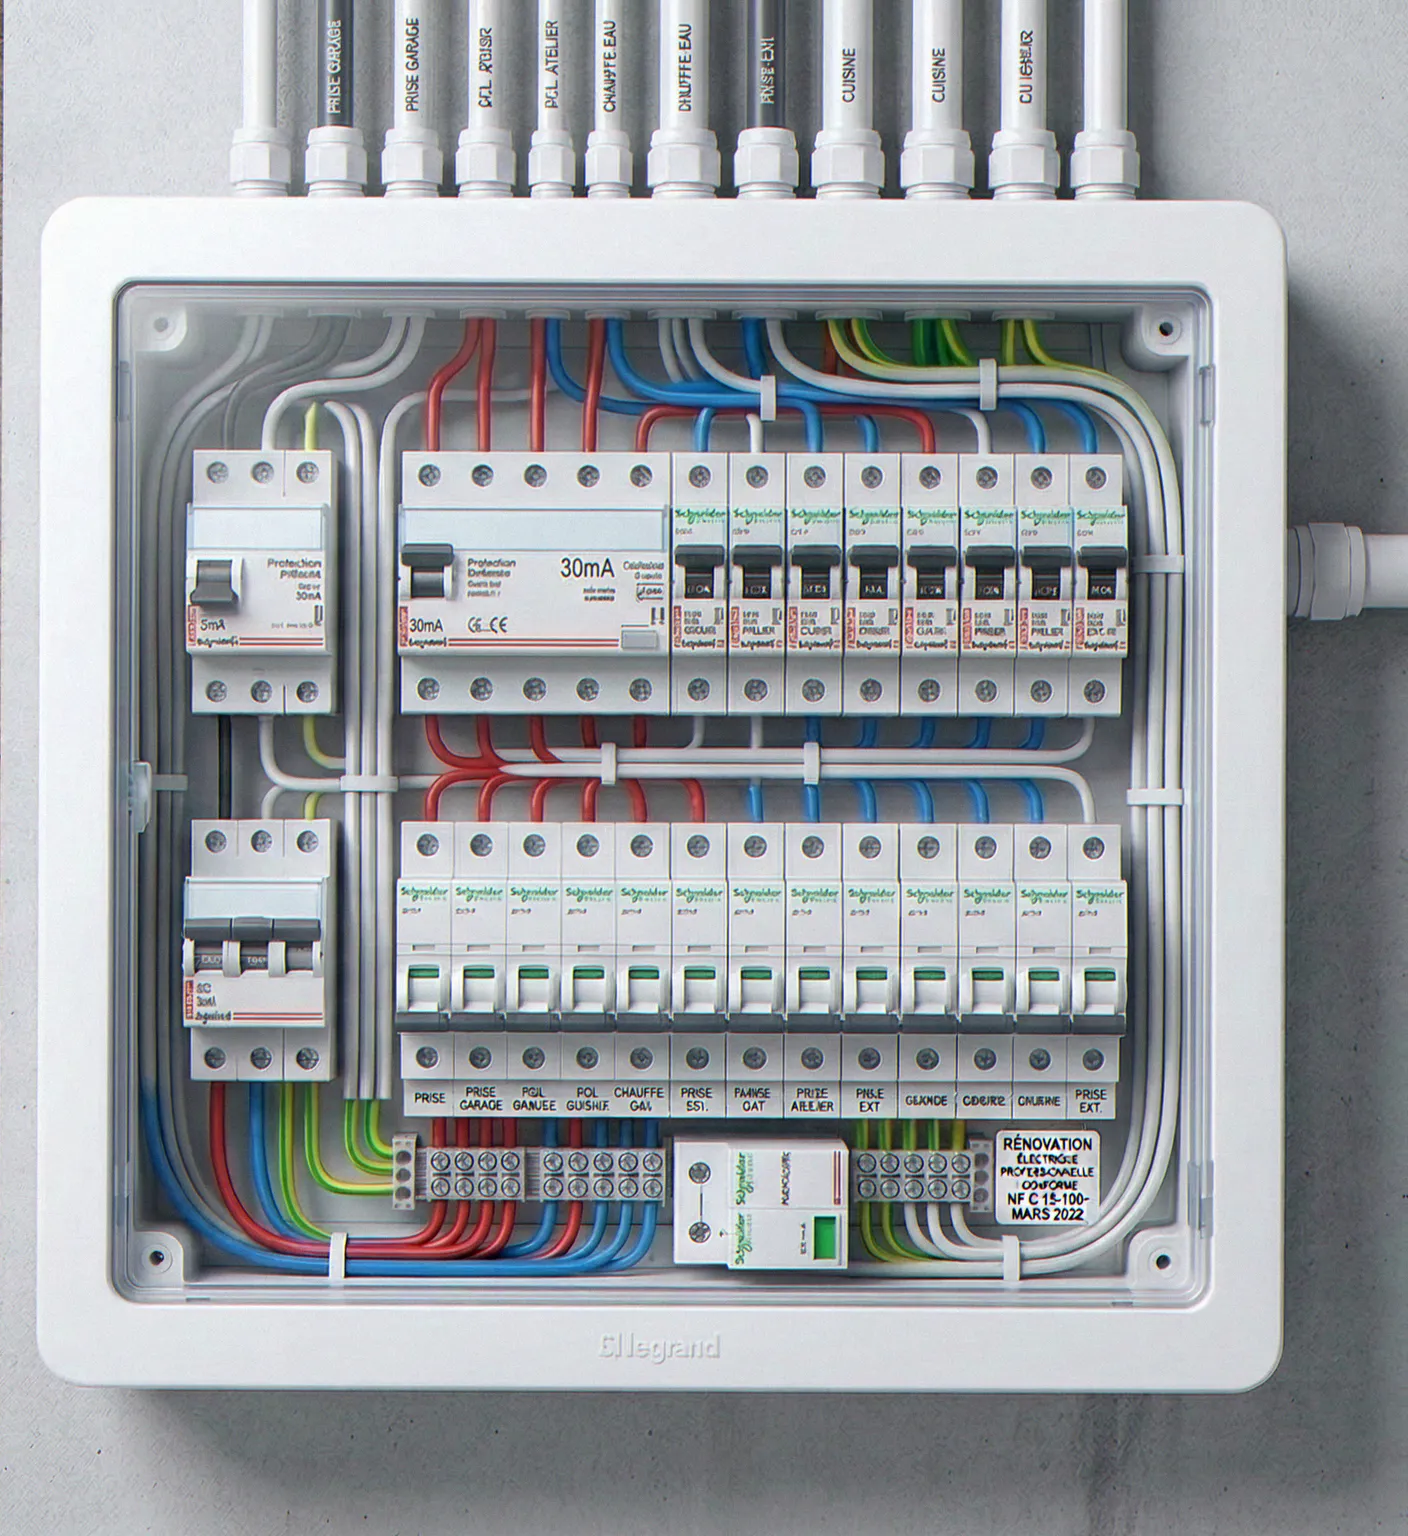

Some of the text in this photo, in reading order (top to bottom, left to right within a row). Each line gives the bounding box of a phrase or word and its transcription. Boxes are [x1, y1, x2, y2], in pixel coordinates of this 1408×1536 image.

[602, 20, 617, 48] EAU
[678, 23, 692, 50] EAU
[545, 20, 559, 75] ATELIER
[405, 18, 420, 112] PRISE GARAGE
[842, 48, 856, 103] CUISINE
[932, 48, 946, 103] CUISINE
[560, 557, 615, 579] 30mA
[409, 617, 444, 633] 30mA
[414, 1092, 446, 1104] PRISE
[465, 1086, 496, 1098] PRISE
[614, 1087, 665, 1098] CHAUFFE
[1075, 1088, 1108, 1100] PRISE
[859, 1101, 881, 1112] EXT
[1079, 1102, 1103, 1114] EXT.
[1003, 1133, 1092, 1151] RÉNOVATION
[1007, 1192, 1025, 1205] NF
[1028, 1192, 1039, 1205] C
[1011, 1207, 1084, 1221] MARS 2022
